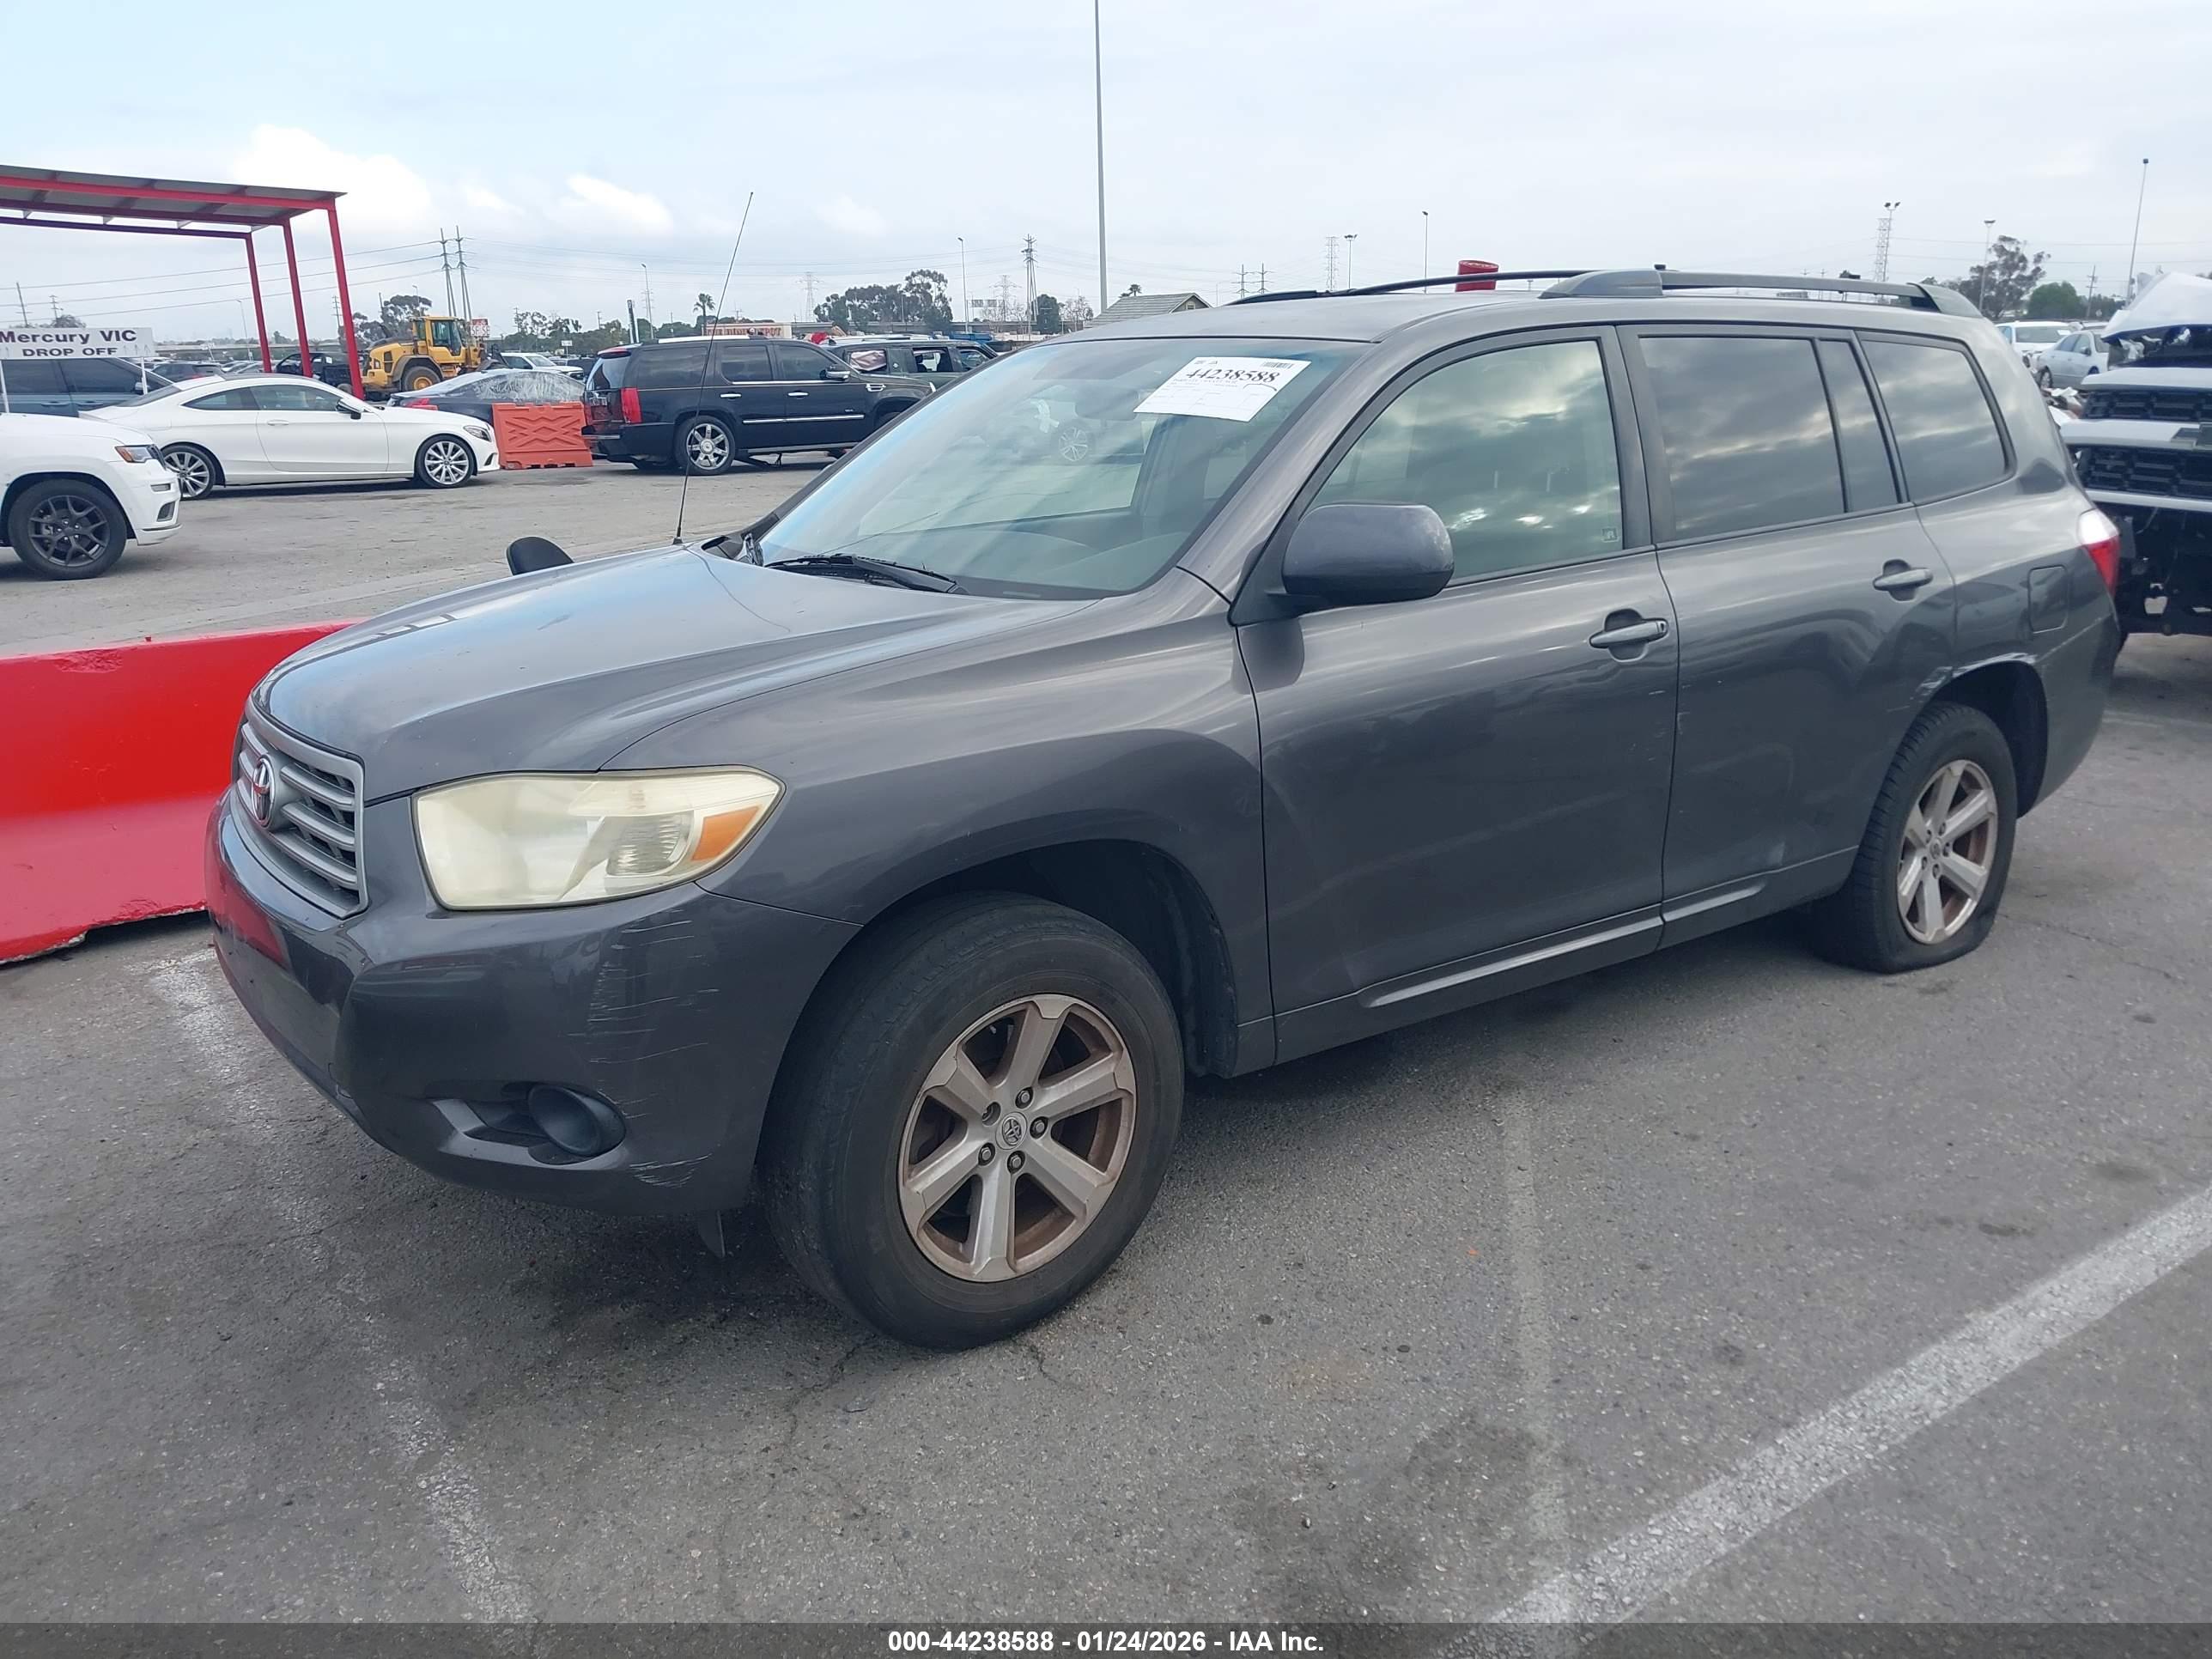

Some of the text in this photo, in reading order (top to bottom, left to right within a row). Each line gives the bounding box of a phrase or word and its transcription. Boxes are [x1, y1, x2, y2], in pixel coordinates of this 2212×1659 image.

[0, 330, 137, 344] Mercury VIC
[22, 347, 118, 357] DROP OFF
[1186, 368, 1280, 383] 44238588
